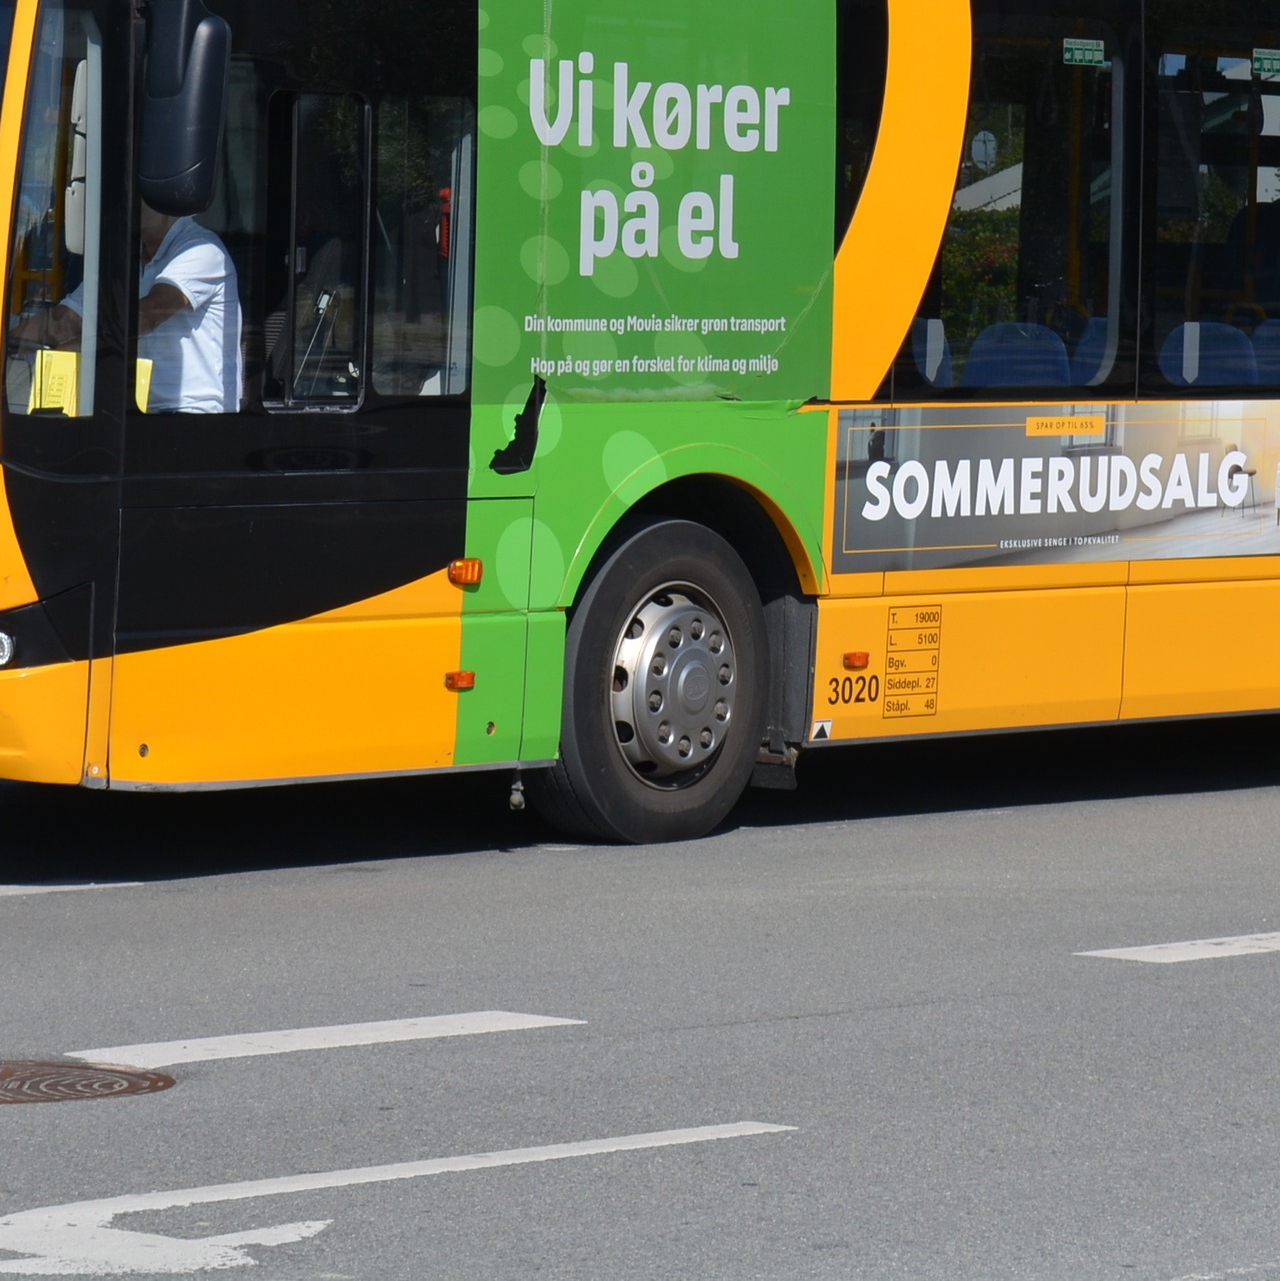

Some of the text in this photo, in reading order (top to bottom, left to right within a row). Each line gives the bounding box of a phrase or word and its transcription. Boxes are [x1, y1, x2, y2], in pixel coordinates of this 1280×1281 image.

[528, 50, 791, 153] Vi kører
[579, 161, 739, 277] på el
[524, 314, 786, 335] Din kommune og Movia sikrer grøn transport
[530, 354, 779, 376] Hop på og gør en forskel for klima og miljø
[1036, 421, 1094, 430] SPAR OP TIL 65%
[861, 450, 1249, 521] SOMMERUDSALG
[999, 538, 1042, 549] EKSKLUSIVE
[1044, 537, 1067, 547] SENGE
[1073, 535, 1119, 546] TOPKVALITET
[891, 611, 940, 624] T. 19000
[889, 633, 939, 646] L. 5100
[888, 655, 937, 670] Bgv. 0
[827, 674, 880, 706] 3020
[887, 676, 936, 691] Siddepl. 27
[885, 698, 935, 714] Ståpl. 48
